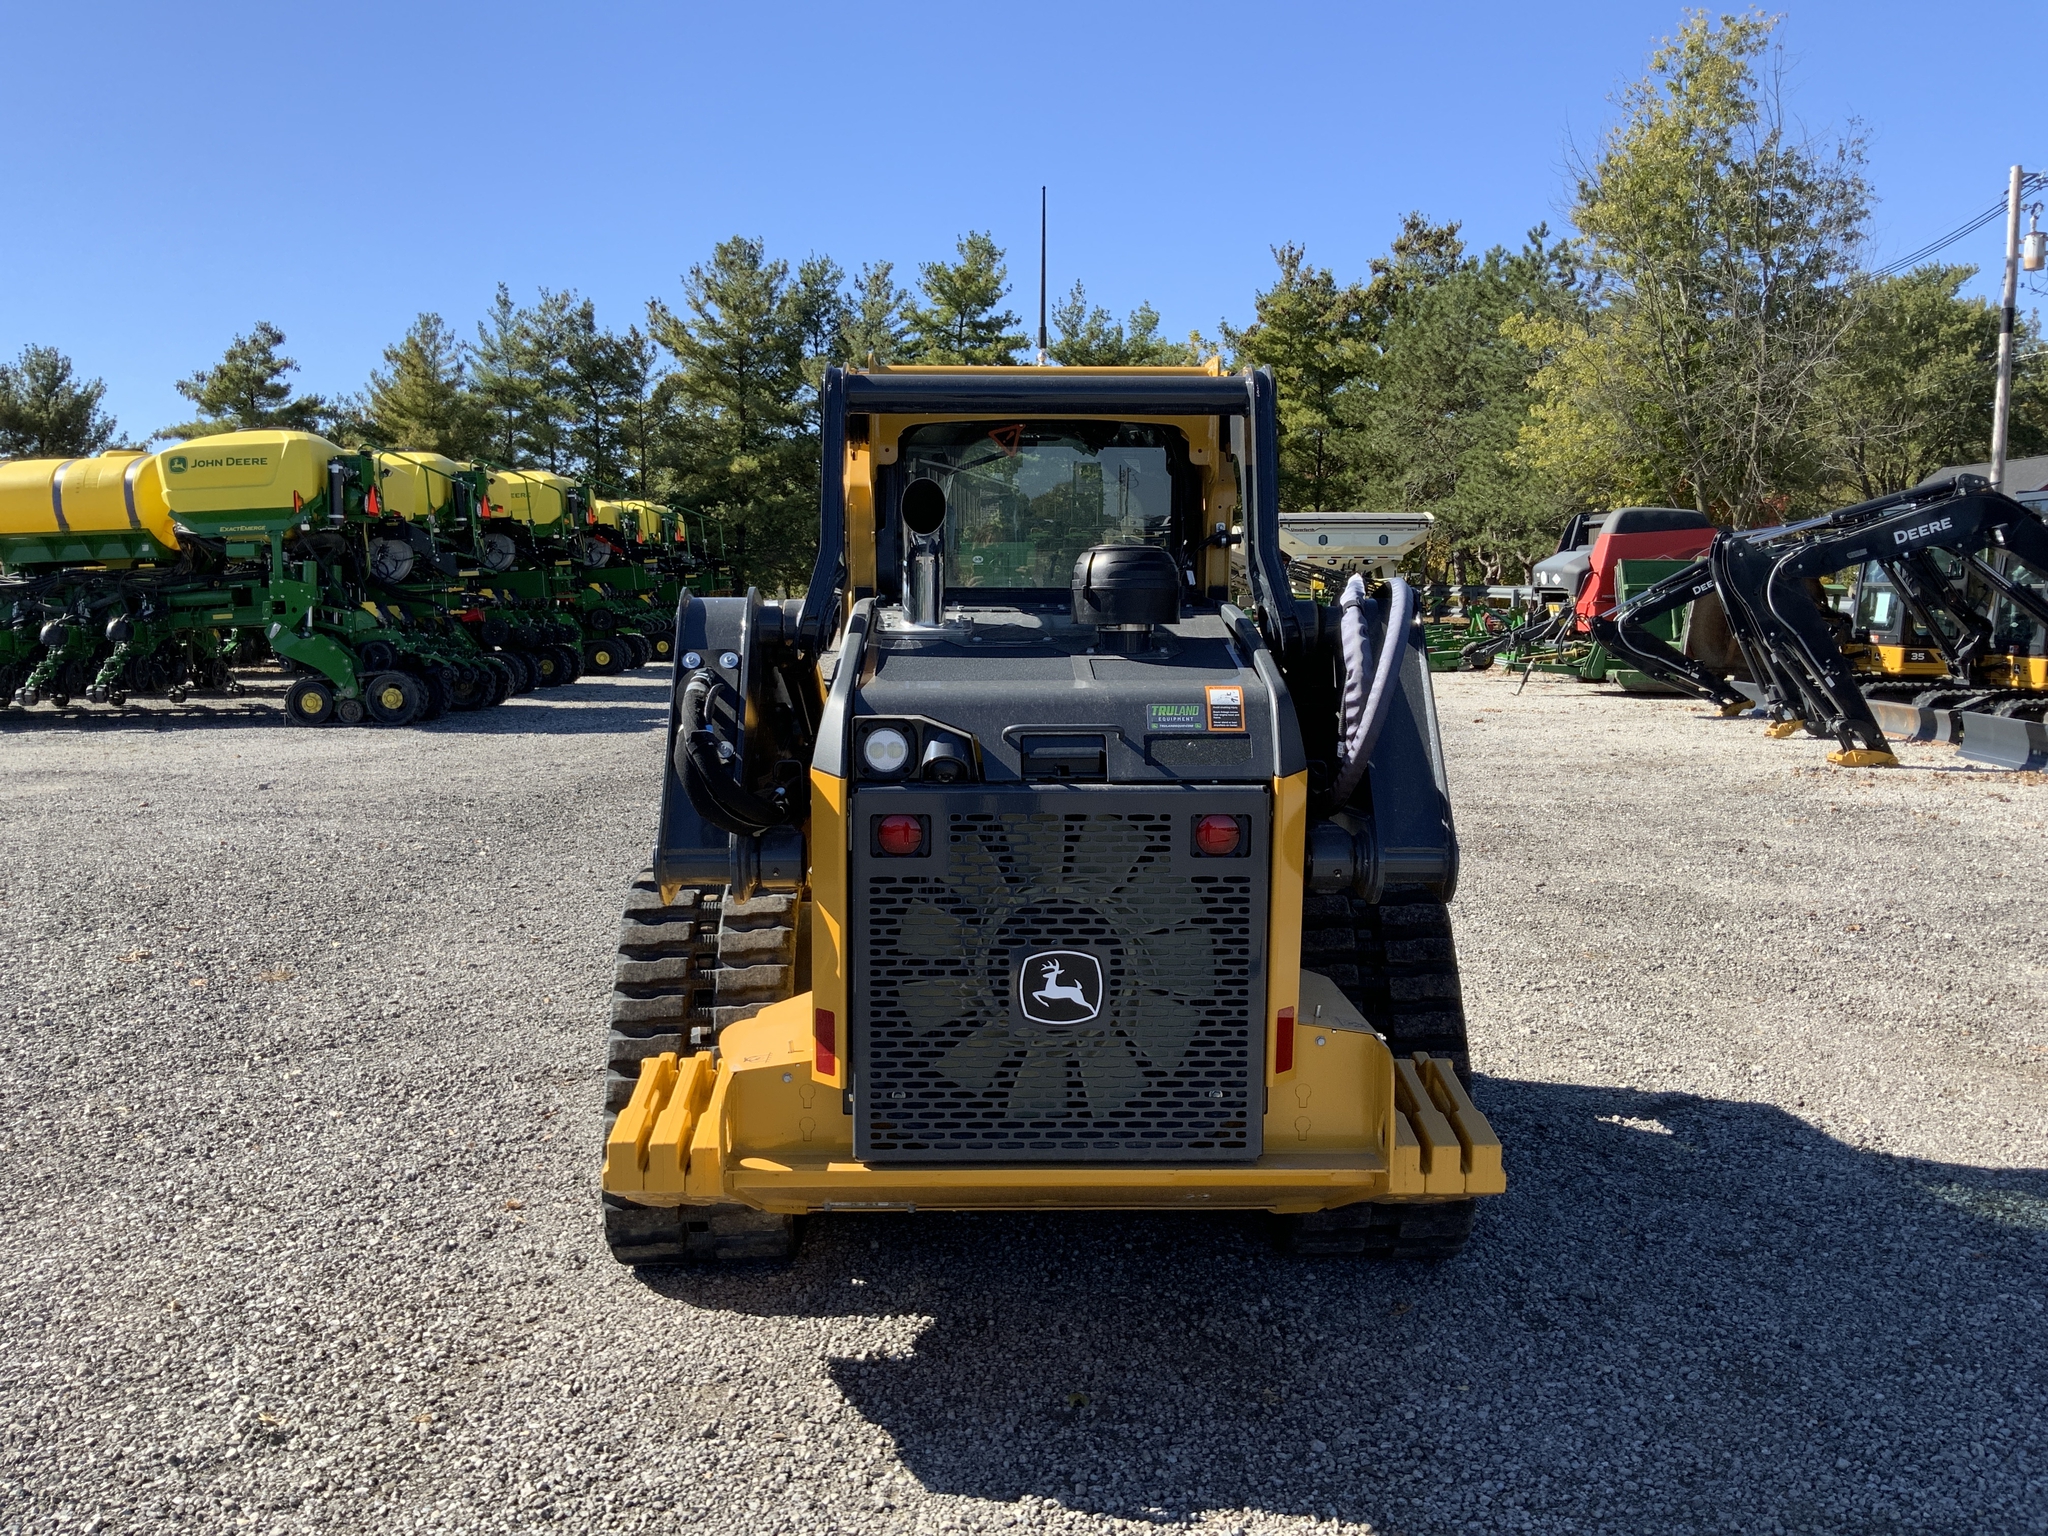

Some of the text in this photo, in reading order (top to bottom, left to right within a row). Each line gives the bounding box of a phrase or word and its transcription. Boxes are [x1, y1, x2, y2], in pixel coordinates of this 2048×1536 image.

[191, 457, 268, 468] JOHN DEERE
[1893, 517, 1953, 545] DEERE
[1692, 580, 1714, 595] DEE
[1910, 652, 1925, 661] 35
[1151, 705, 1200, 716] TRULAND
